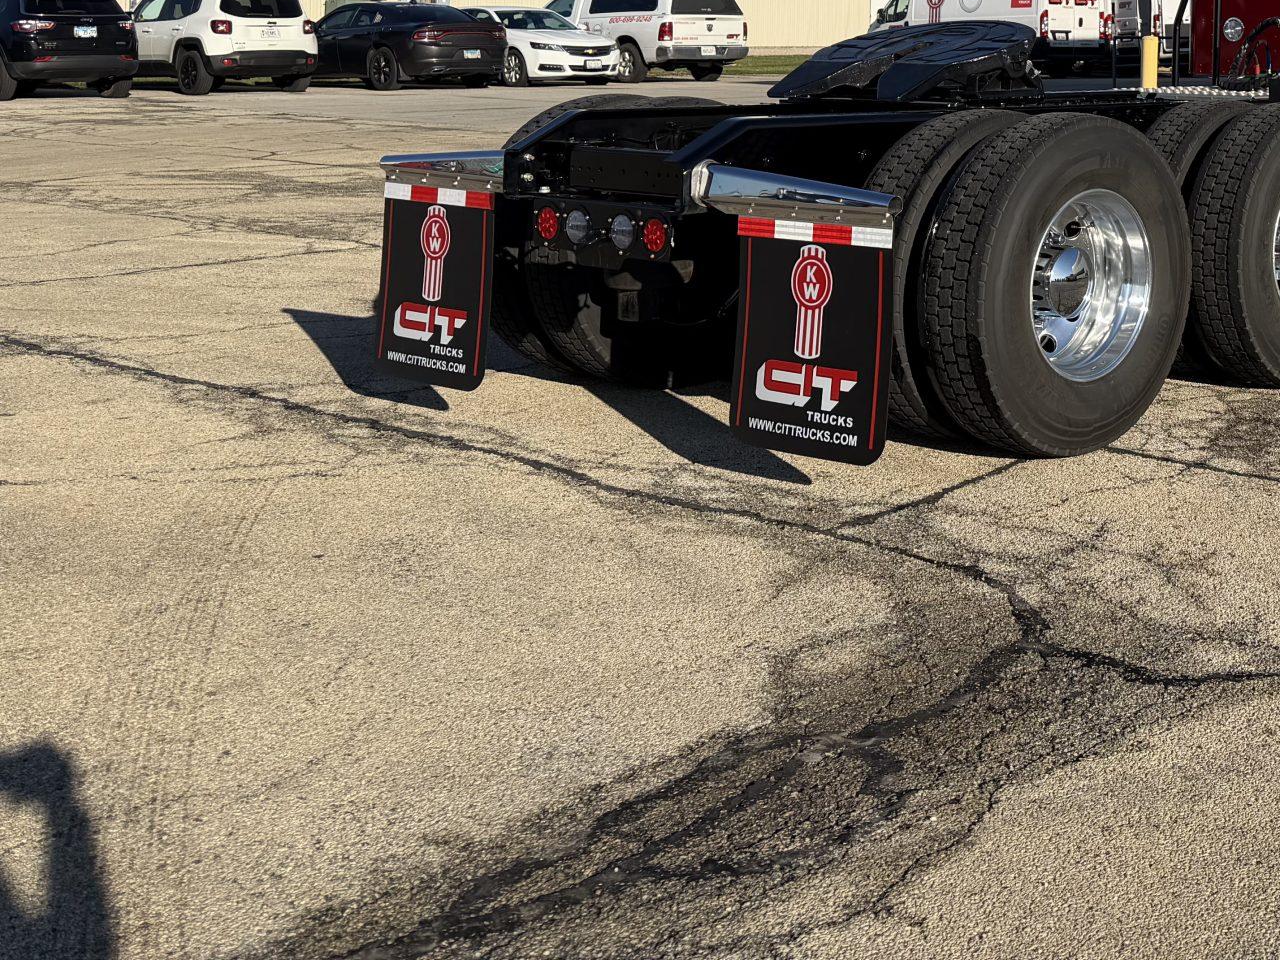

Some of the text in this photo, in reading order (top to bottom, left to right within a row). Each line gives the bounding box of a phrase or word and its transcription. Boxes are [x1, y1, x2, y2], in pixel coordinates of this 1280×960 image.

[394, 302, 467, 344] CIT
[387, 350, 466, 374] WWW.CITTRUCKS.COM
[430, 344, 464, 358] TRUCKS
[755, 359, 858, 412] CIT
[748, 416, 858, 447] WWW.CITTRUCKS.COM
[806, 411, 854, 428] TRUCKS
